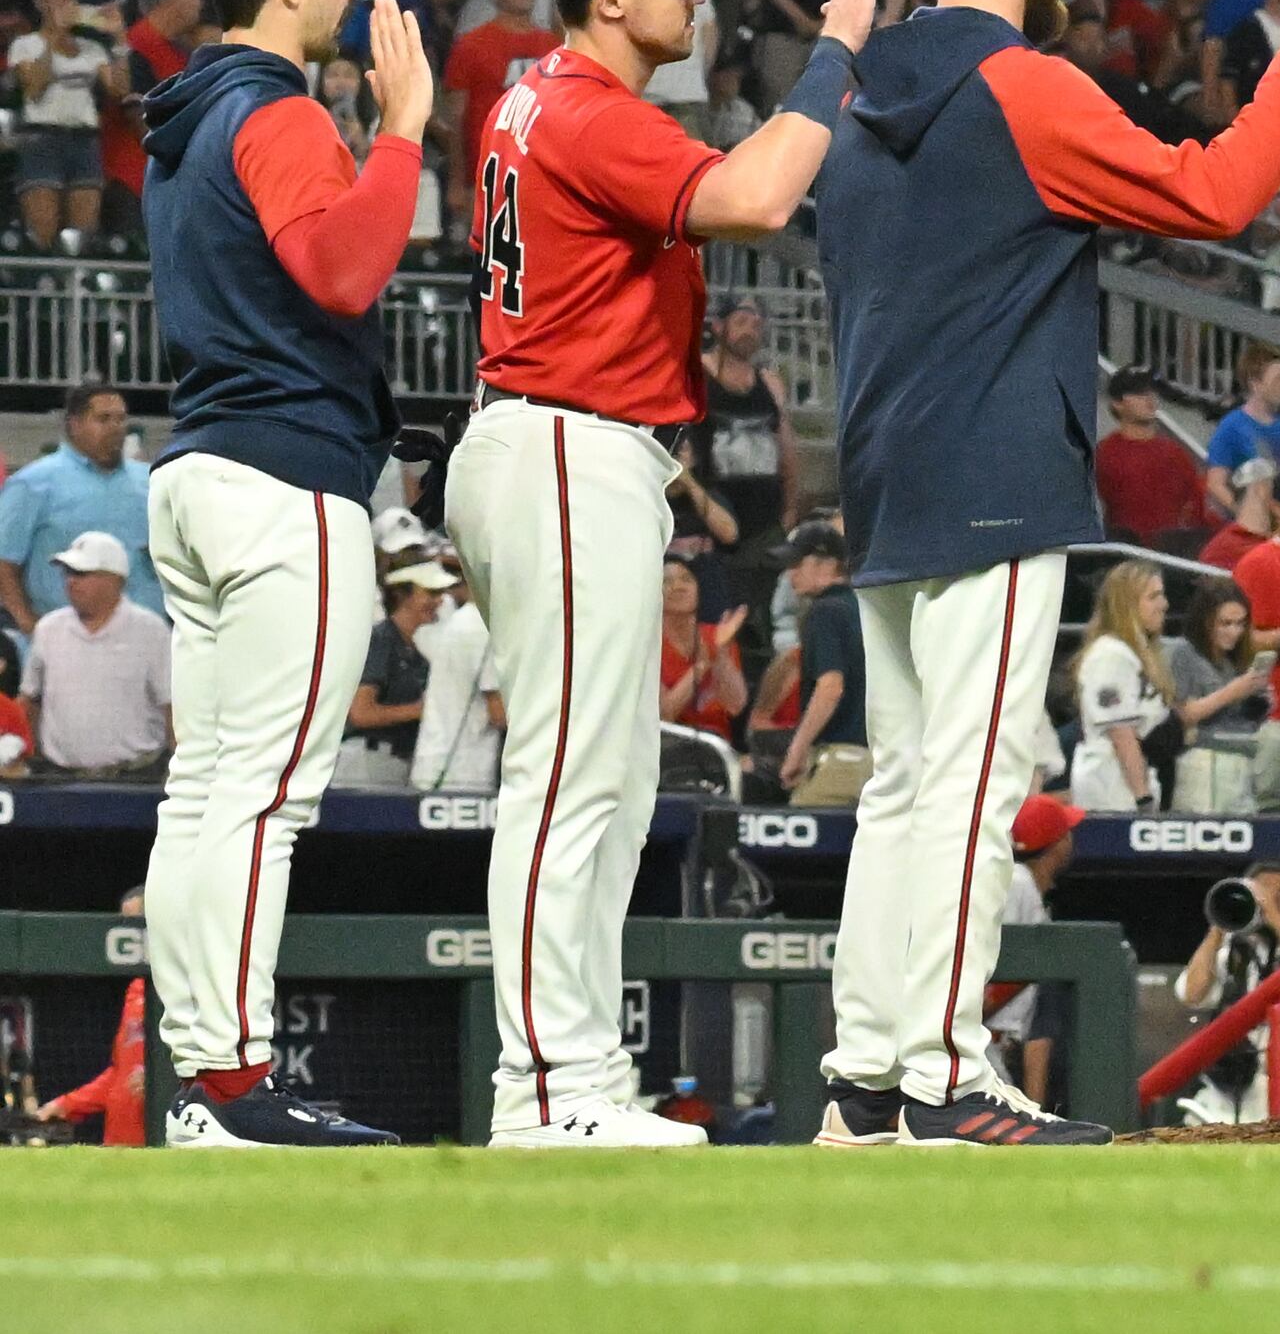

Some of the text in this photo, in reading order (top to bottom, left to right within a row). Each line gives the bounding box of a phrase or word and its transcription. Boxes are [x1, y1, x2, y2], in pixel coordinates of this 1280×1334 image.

[479, 150, 525, 319] 14
[419, 796, 499, 830] GEI
[738, 813, 818, 848] ICO
[1129, 820, 1254, 852] GEICO
